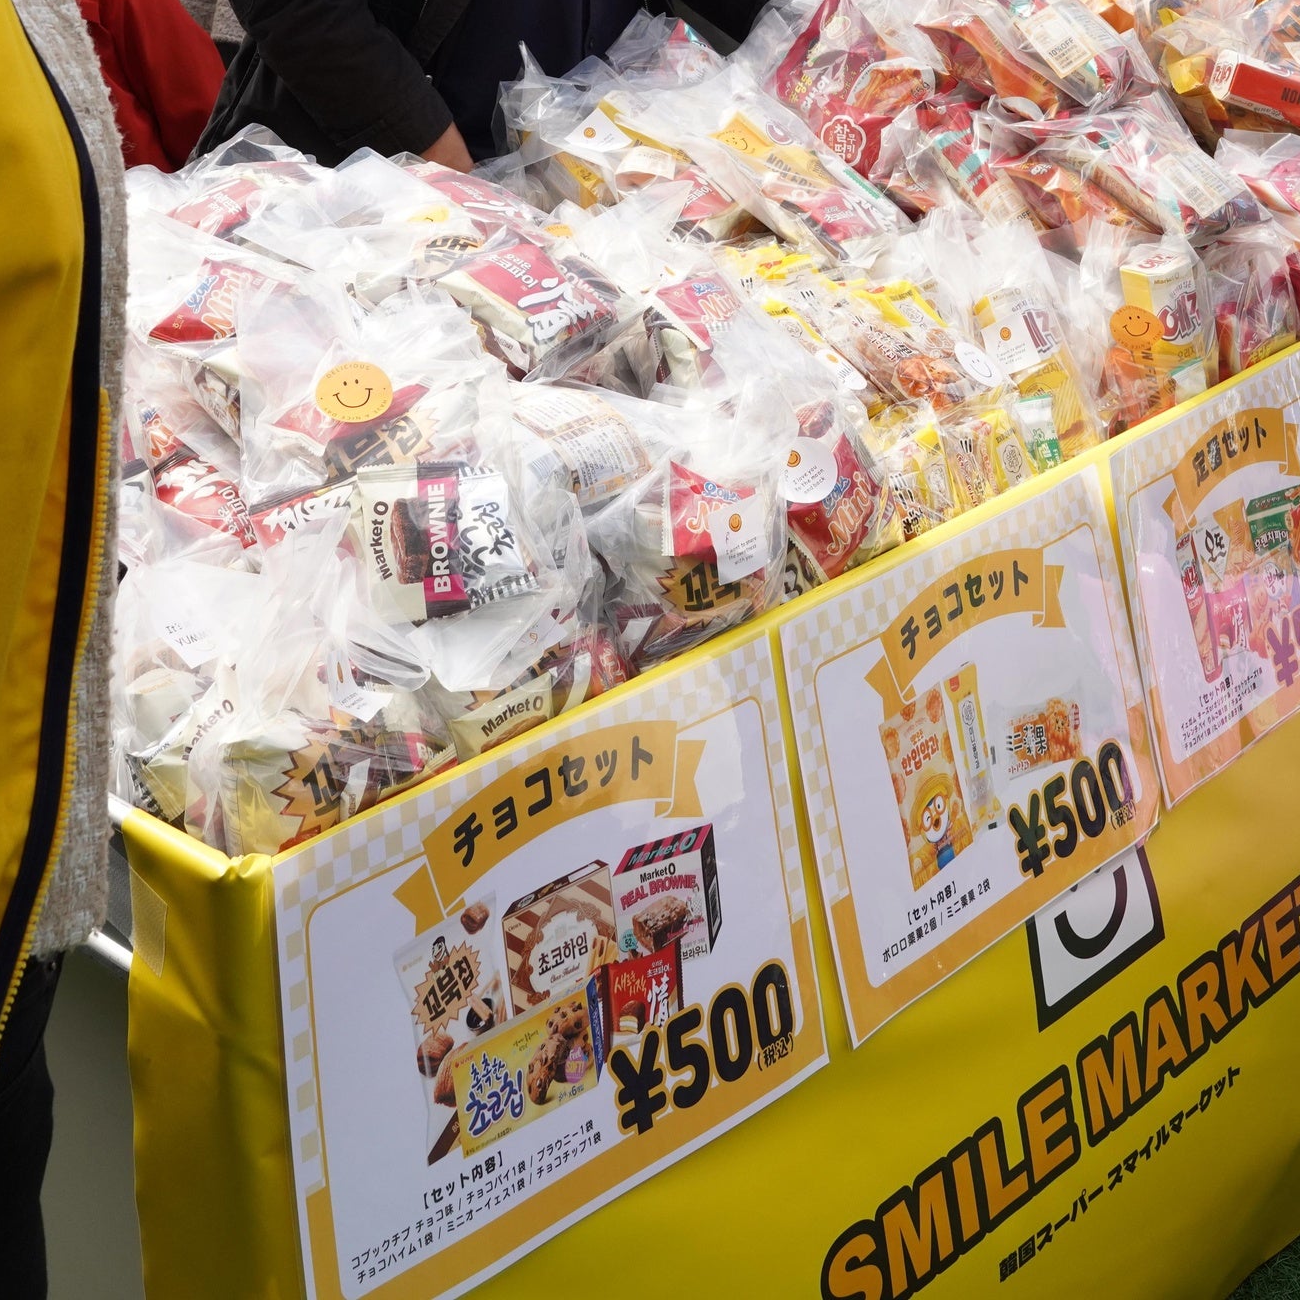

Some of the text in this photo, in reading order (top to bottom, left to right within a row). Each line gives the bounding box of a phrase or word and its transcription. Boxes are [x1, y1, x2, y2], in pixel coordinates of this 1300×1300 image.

[503, 253, 532, 271] 오리온
[326, 363, 371, 380] DELICIOUS
[1191, 417, 1268, 488] 定番セット
[370, 501, 394, 580] Market O
[428, 483, 452, 593] BROWNIE
[827, 471, 873, 556] Mini
[899, 561, 1030, 662] チョコセット
[181, 699, 236, 761] Market O
[481, 695, 544, 738] Market O
[900, 734, 940, 776] 한입약과
[452, 734, 655, 868] チョコセット
[1009, 741, 1132, 878] ¥500
[630, 832, 697, 865] Market O
[640, 862, 676, 884] Market O
[620, 874, 697, 910] REAL BROWNIE
[907, 881, 957, 925] 【セット内容】
[422, 956, 474, 1022] 꼬북칩
[471, 1052, 505, 1093] 촉촉한
[611, 964, 794, 1136] ¥500
[757, 1033, 796, 1072] (税込)
[466, 1070, 525, 1136] 초코칩
[423, 1151, 504, 1209] 【セット内容】
[820, 1065, 1081, 1300] SMILE
[999, 1066, 1242, 1283] 韓国スーパー スマイルマーケット
[415, 1203, 454, 1234] チョコ味
[357, 1232, 434, 1284] チョコハイム1袋
